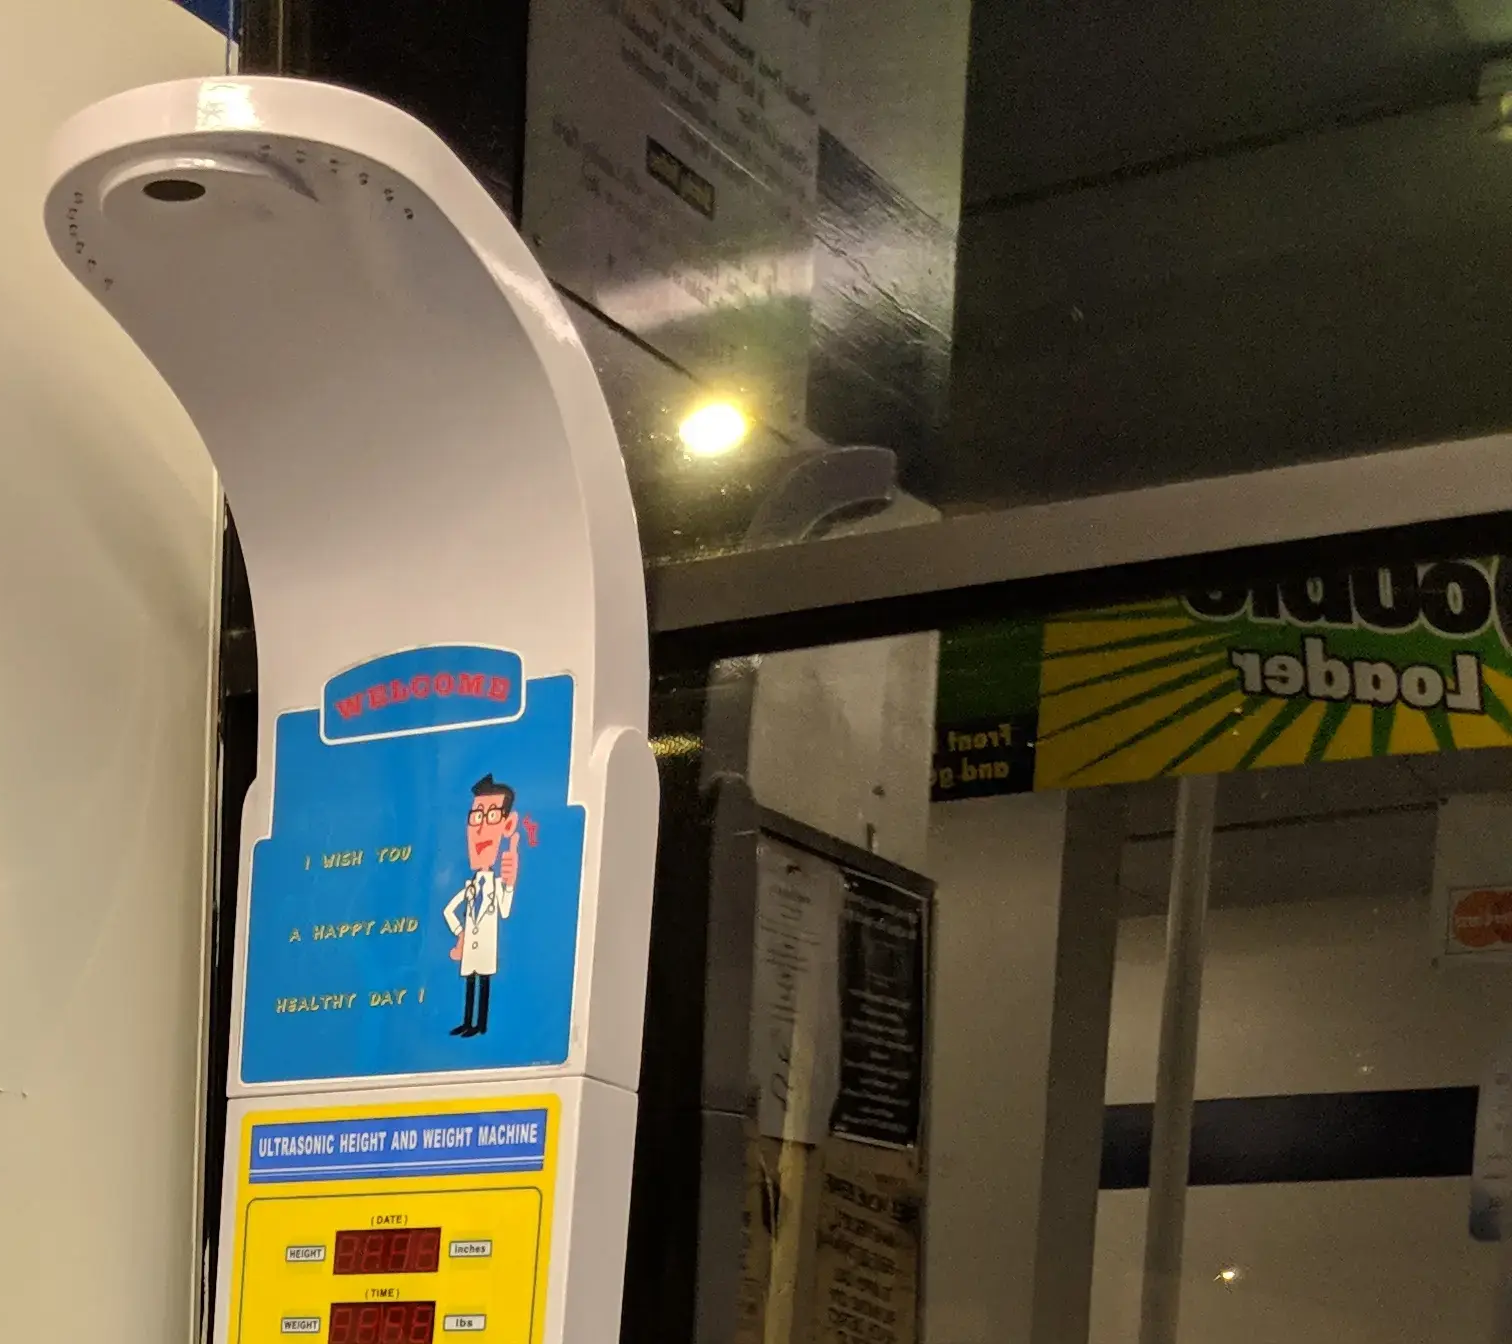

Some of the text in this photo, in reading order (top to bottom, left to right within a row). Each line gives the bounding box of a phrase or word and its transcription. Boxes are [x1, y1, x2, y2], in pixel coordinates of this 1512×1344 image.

[335, 672, 510, 720] WELCOME
[305, 845, 412, 870] I WISH YOU
[289, 917, 418, 943] A HAPPY AND
[276, 989, 406, 1014] HEALTHY DAY
[259, 1122, 538, 1158] ULTRASONIC HEIGHT AND WEIGHT MACHINE
[289, 1247, 322, 1260] HEIGHT
[454, 1243, 486, 1256] inches
[284, 1320, 318, 1331] WEIGHT
[455, 1317, 473, 1328] lbs
